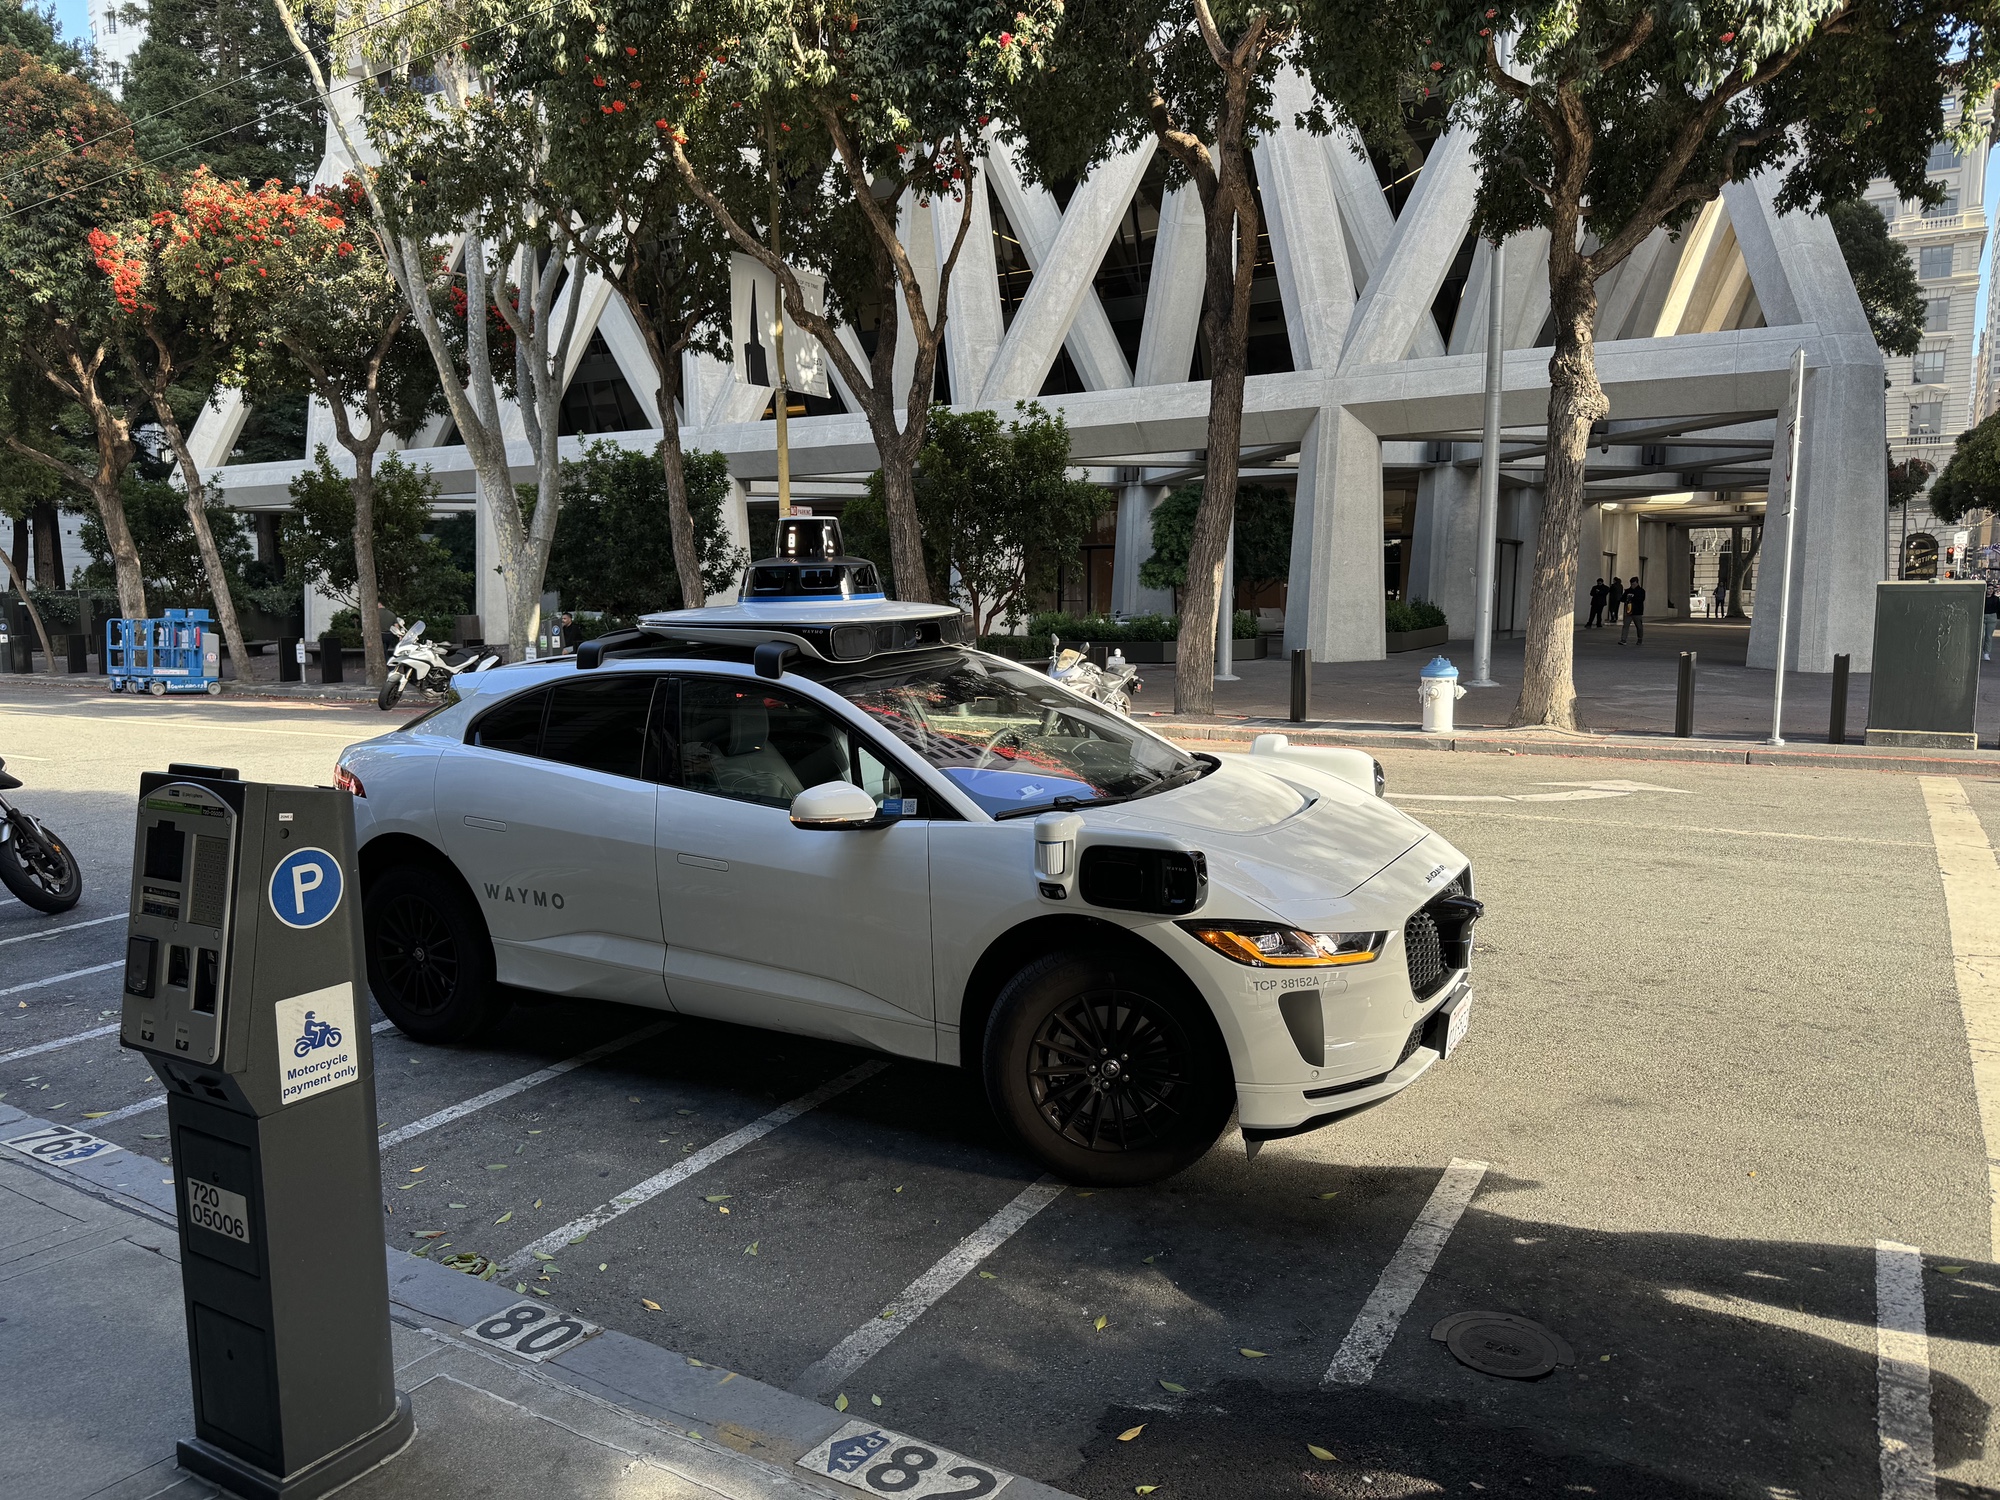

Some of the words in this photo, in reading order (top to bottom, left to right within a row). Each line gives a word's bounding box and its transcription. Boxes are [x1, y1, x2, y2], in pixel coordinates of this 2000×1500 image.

[292, 862, 324, 914] P
[483, 882, 565, 910] WAYMO
[1252, 979, 1277, 991] TCP
[1280, 975, 1320, 989] 38152A
[287, 1054, 348, 1080] Motorcycle
[283, 1072, 331, 1099] payment
[334, 1065, 356, 1080] only
[8, 1126, 93, 1155] 76
[56, 1143, 98, 1159] PAY
[191, 1180, 219, 1208] 720
[192, 1203, 244, 1239] 05006
[476, 1305, 584, 1354] 80
[1484, 1339, 1521, 1355] GAS
[837, 1435, 884, 1470] PAY
[865, 1445, 998, 1500] 82
